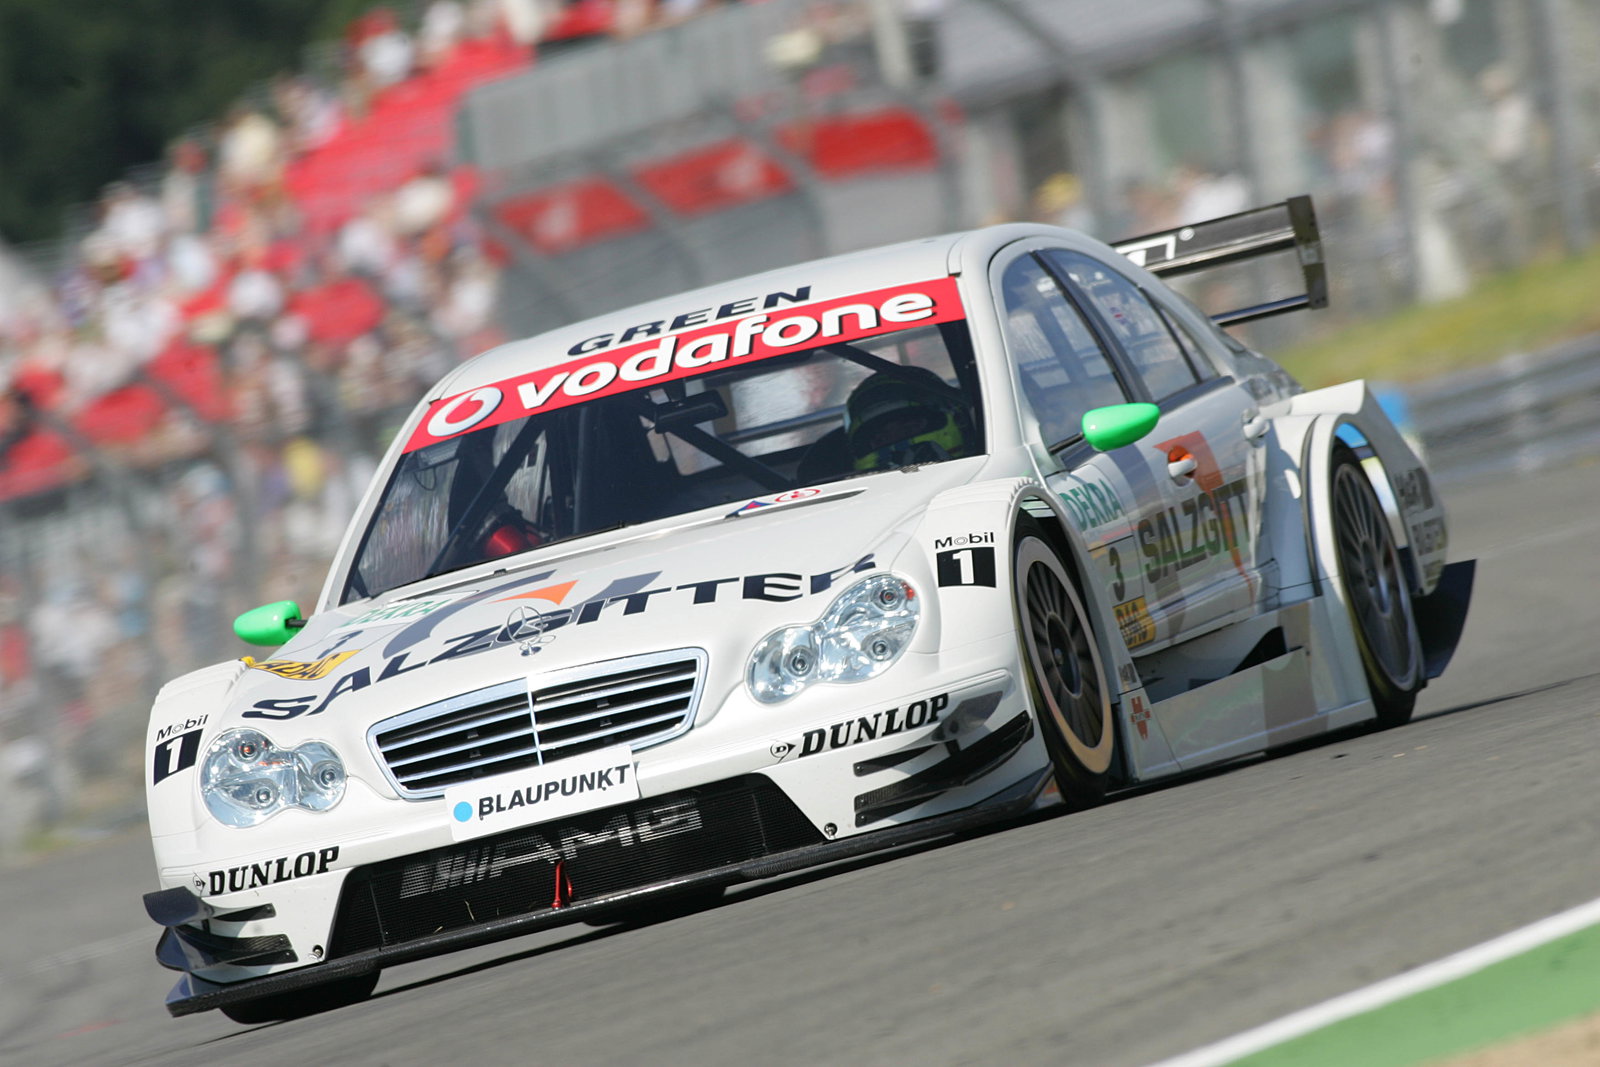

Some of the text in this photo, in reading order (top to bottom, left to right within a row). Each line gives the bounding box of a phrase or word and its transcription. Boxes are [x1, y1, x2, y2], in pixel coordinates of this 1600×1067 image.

[567, 286, 811, 355] GREEN
[517, 293, 934, 409] vodafone
[1058, 478, 1126, 532] DEKRA
[935, 532, 994, 549] Mobil
[1108, 546, 1125, 601] 3
[156, 714, 209, 742] Mobil
[798, 692, 949, 759] DUNLOP
[478, 764, 630, 820] BLAUPUNKT
[209, 846, 340, 896] DUNLOP
